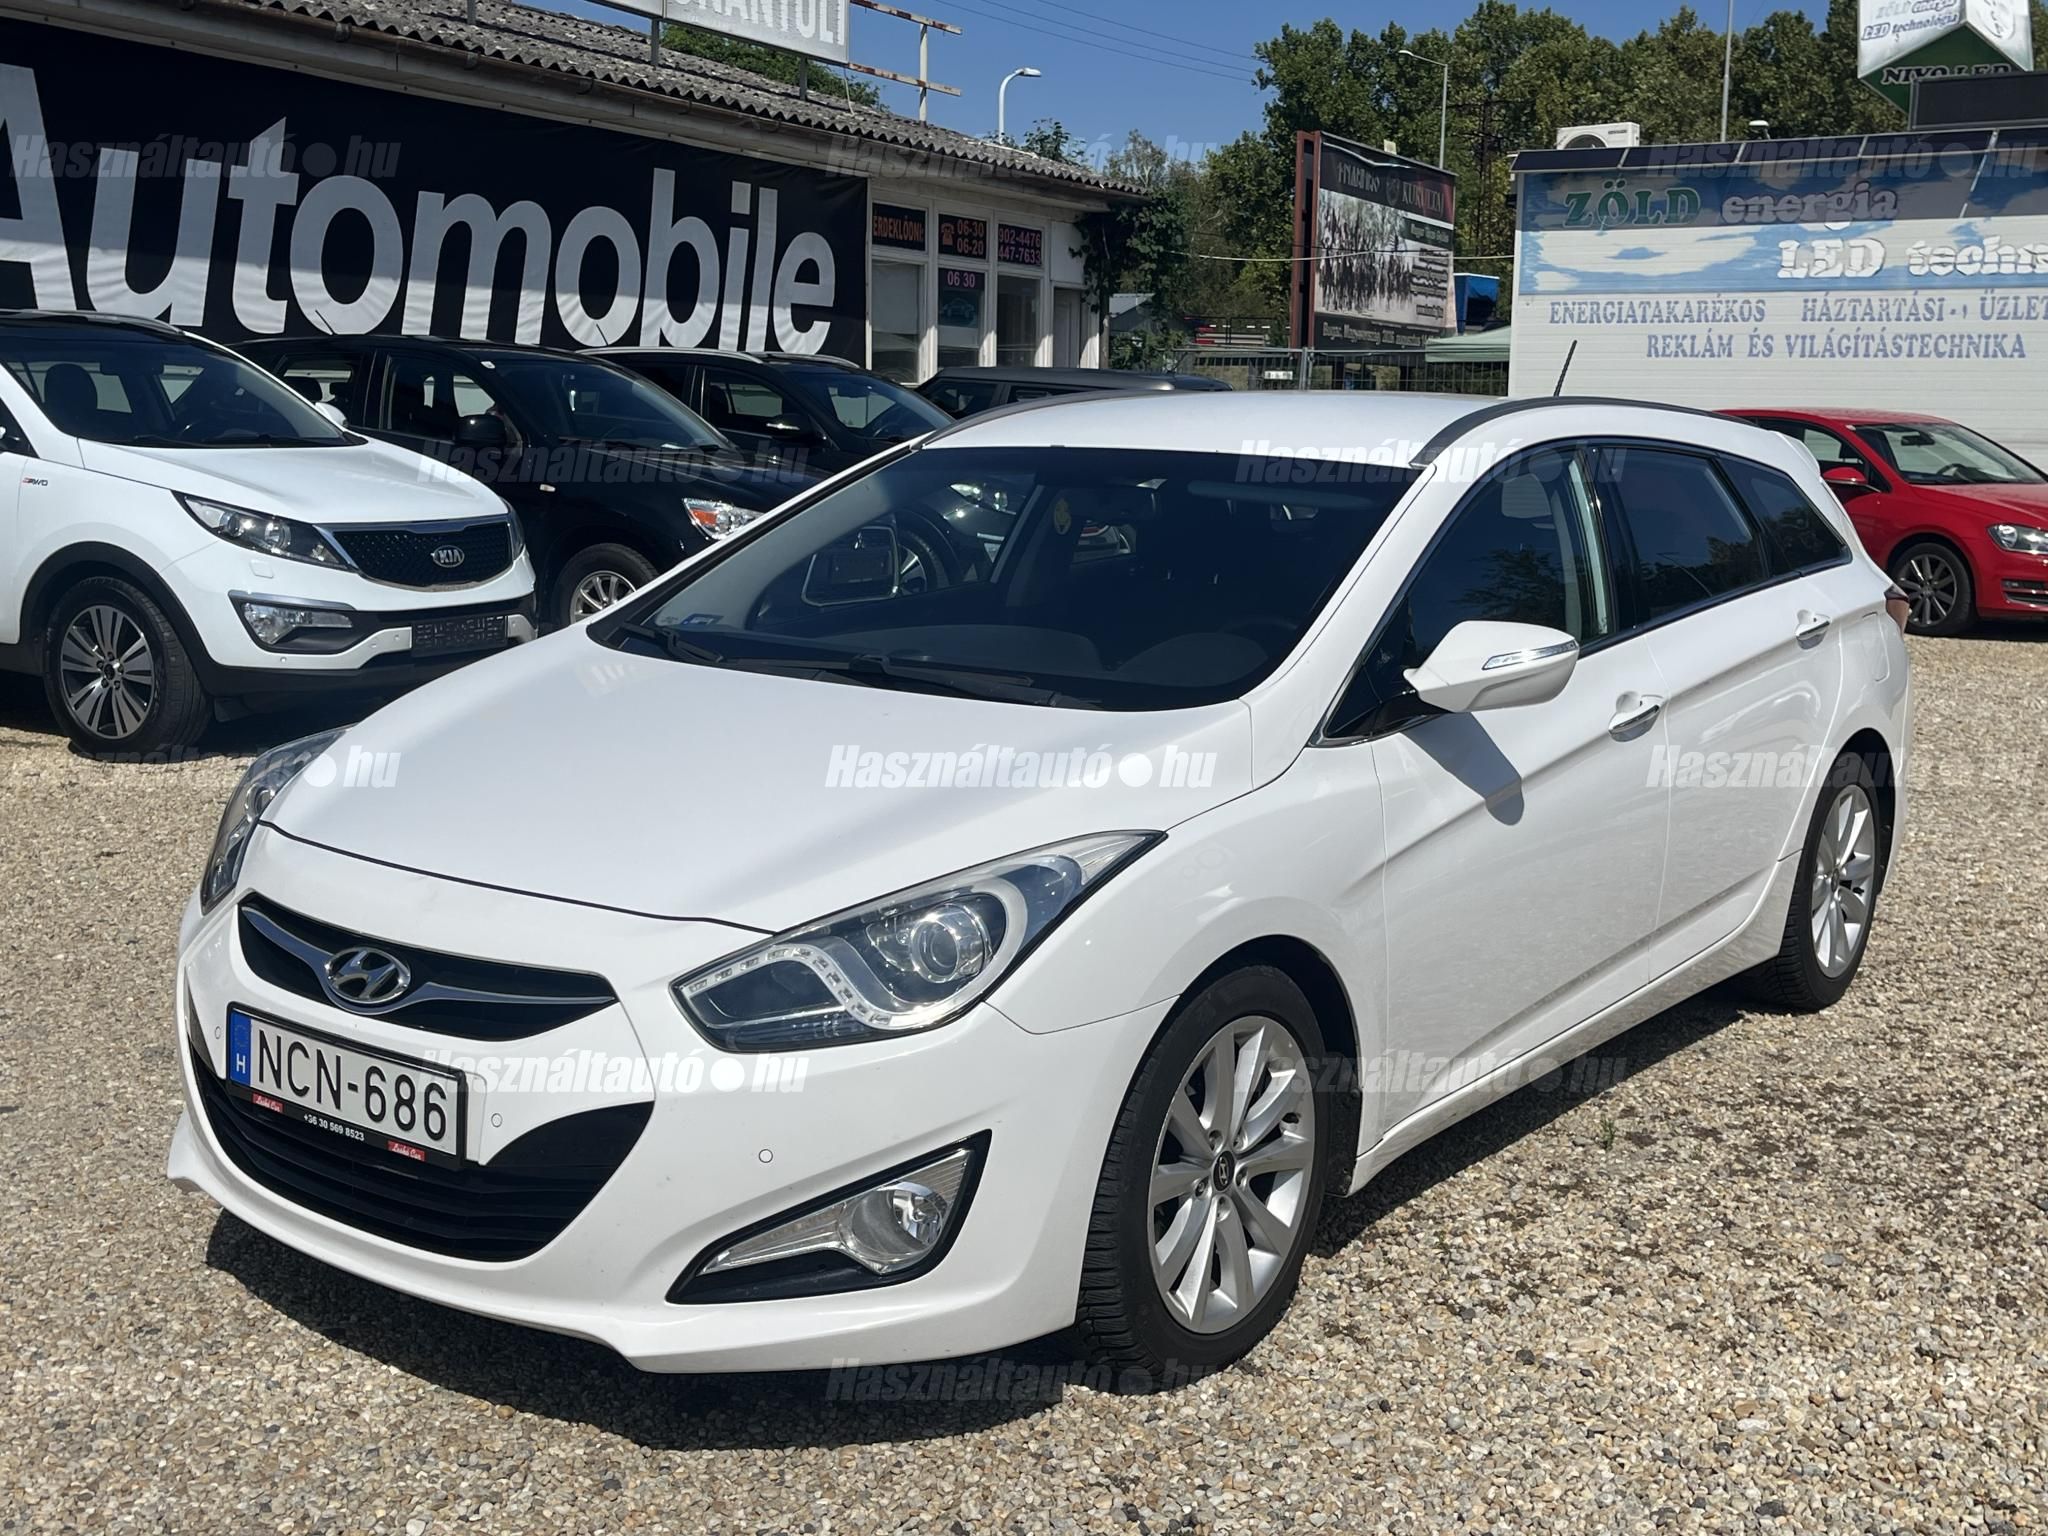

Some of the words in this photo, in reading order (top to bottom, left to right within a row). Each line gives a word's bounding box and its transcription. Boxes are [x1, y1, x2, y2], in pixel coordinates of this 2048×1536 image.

[1563, 178, 1700, 228] ZÖLD
[1720, 181, 1898, 230] energia
[957, 219, 984, 237] 06-30
[999, 227, 1041, 248] 902-4476
[957, 238, 984, 255] 06-20
[999, 246, 1041, 265] 447-7633
[1777, 237, 1886, 278] LED
[947, 271, 960, 287] 06
[963, 273, 976, 288] 30
[1550, 293, 1766, 324] ENERGIATAKARÉKOS
[1646, 327, 1733, 358] REKLÁM
[1747, 327, 1774, 358] ÉS
[1785, 327, 2026, 358] VILÁGÍTÁSTECHNIKA
[438, 549, 460, 563] KIA
[236, 1053, 246, 1074] H
[259, 1029, 446, 1141] NCN-686
[304, 1114, 317, 1125] +36
[319, 1119, 328, 1129] 30
[330, 1122, 343, 1134] 569
[345, 1128, 364, 1141] 8523
